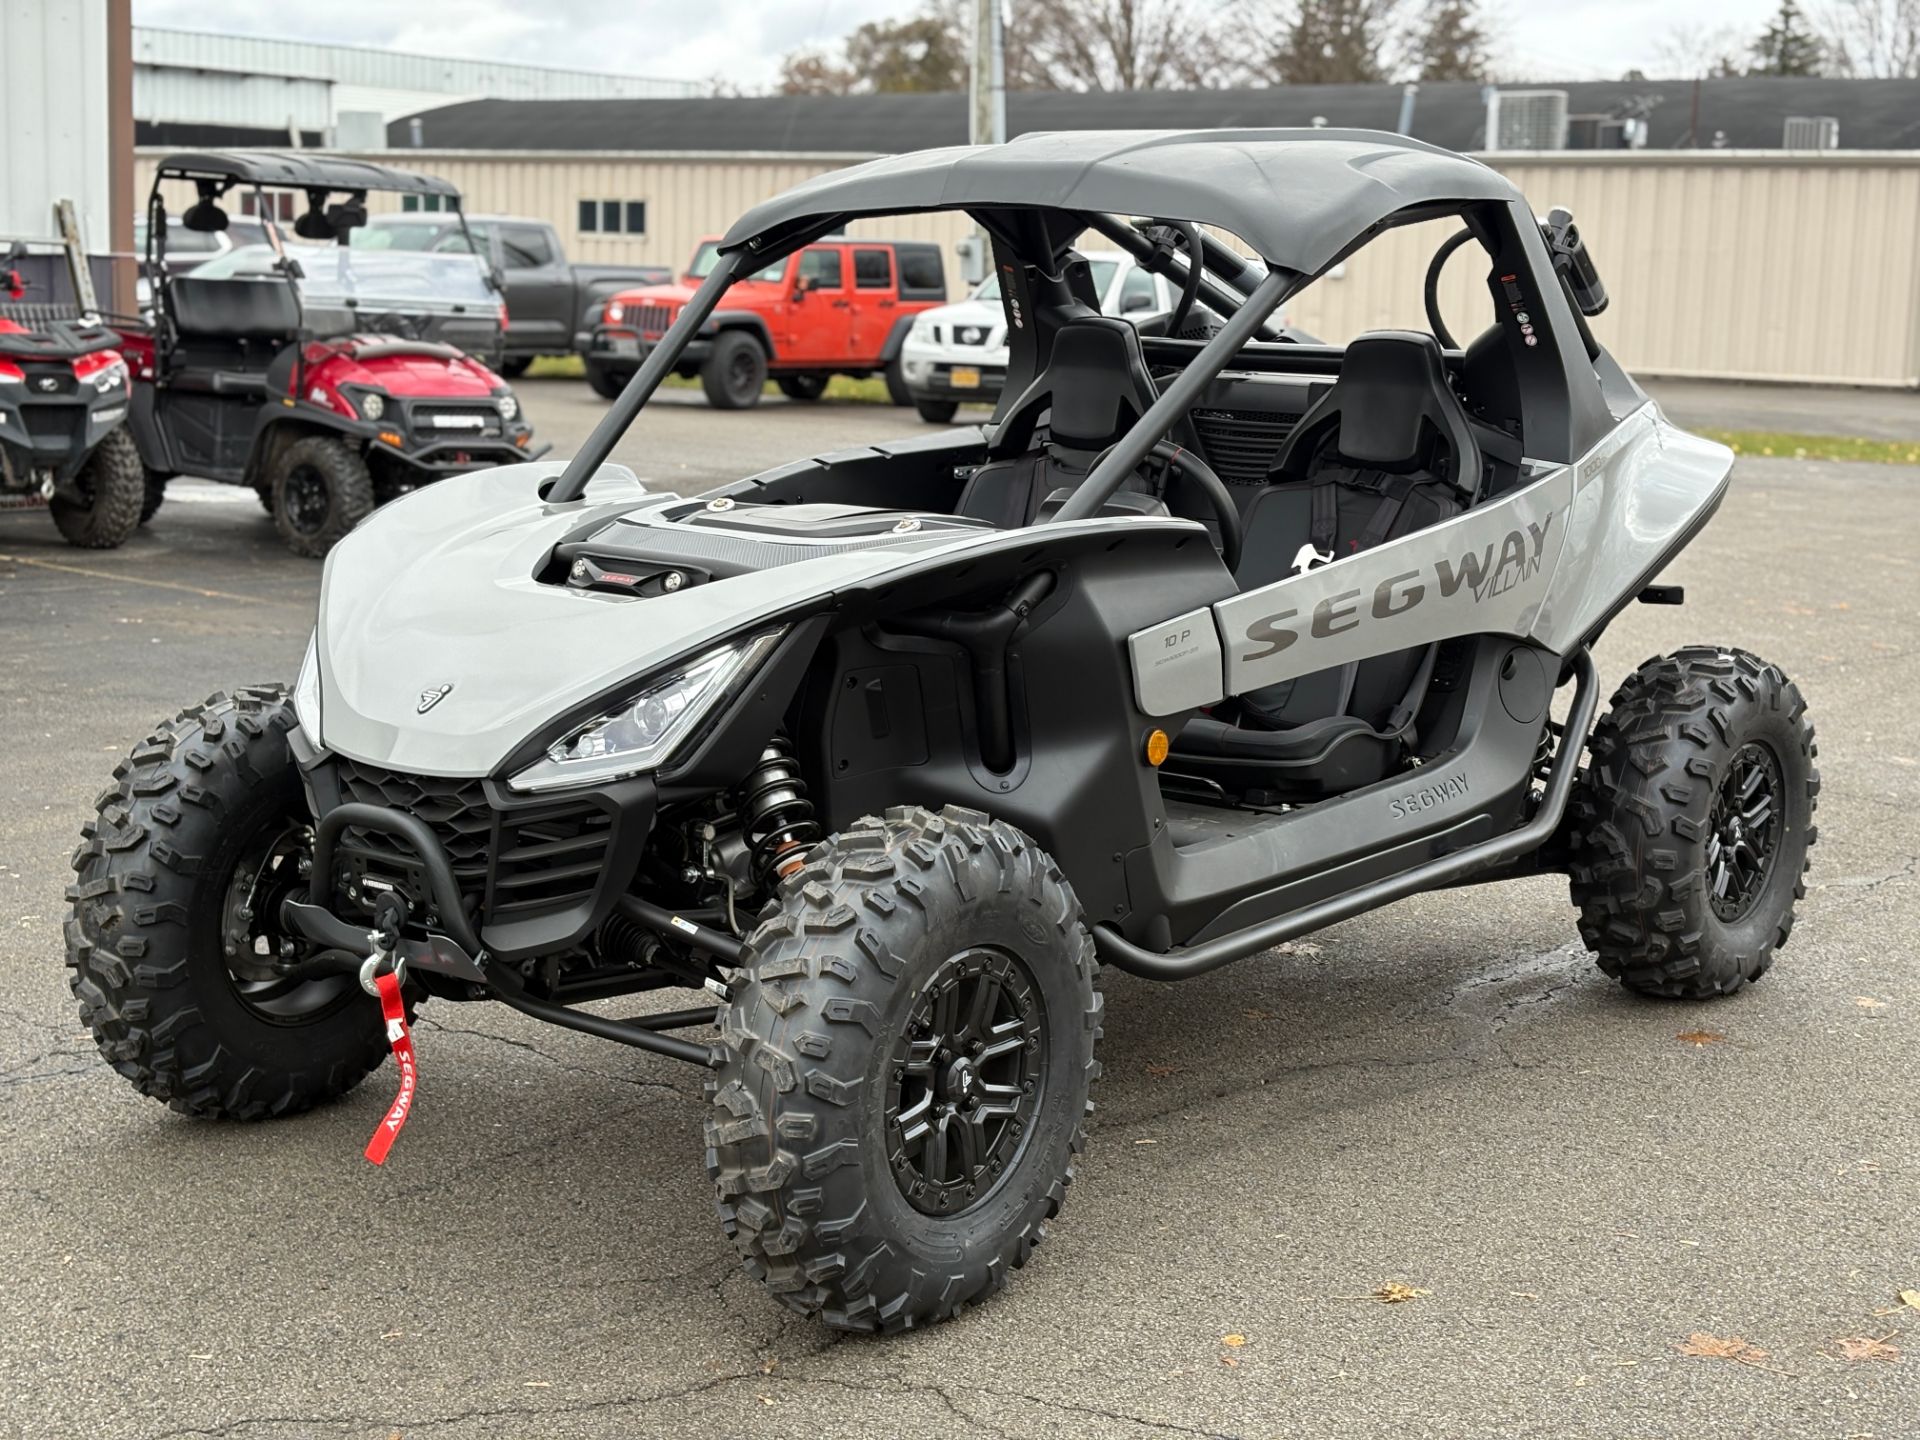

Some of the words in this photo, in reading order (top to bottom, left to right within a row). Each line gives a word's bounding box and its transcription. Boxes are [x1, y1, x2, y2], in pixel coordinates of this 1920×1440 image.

[1242, 511, 1553, 662] SEGWAY
[1472, 552, 1541, 604] VILLAIN
[1163, 634, 1178, 648] 10
[1181, 629, 1191, 643] P
[1388, 772, 1469, 820] SEGWAY
[386, 1050, 413, 1133] SEGWAY
